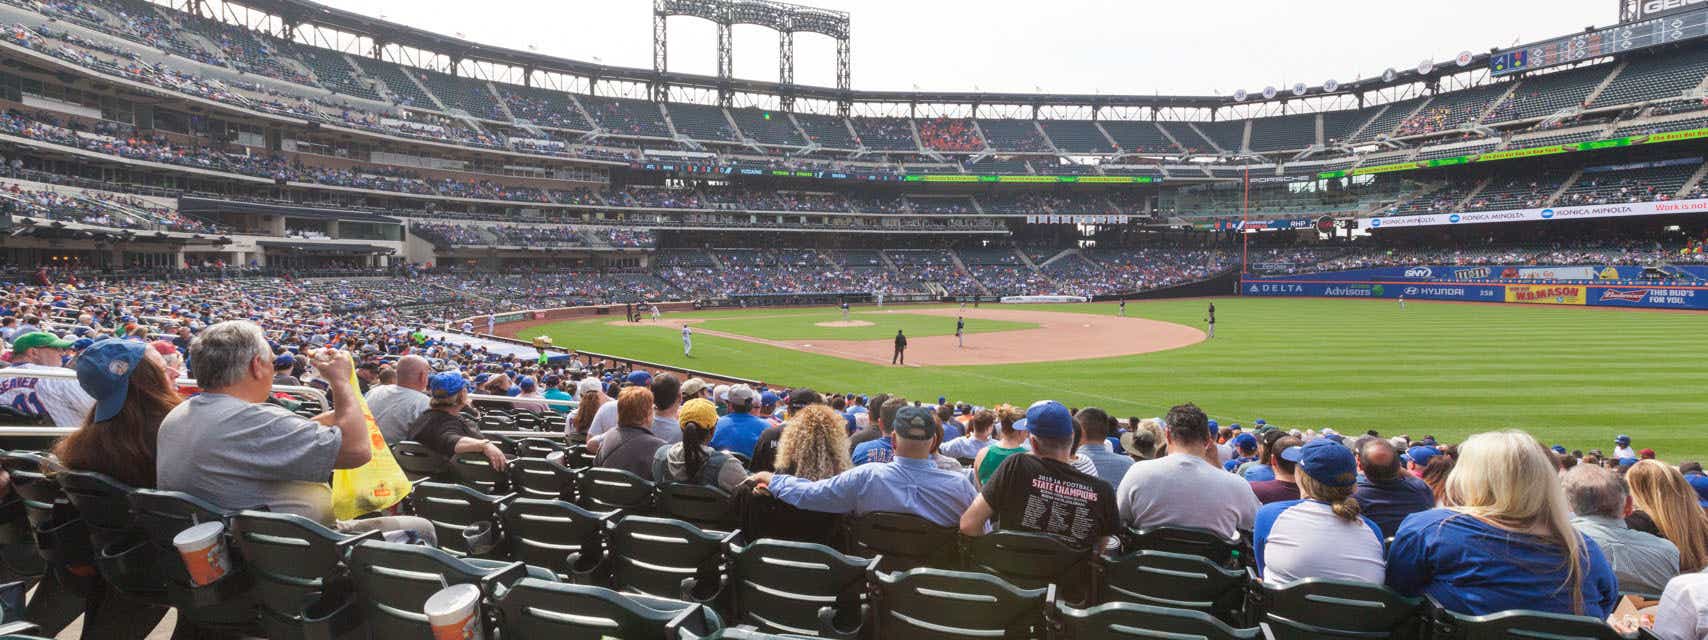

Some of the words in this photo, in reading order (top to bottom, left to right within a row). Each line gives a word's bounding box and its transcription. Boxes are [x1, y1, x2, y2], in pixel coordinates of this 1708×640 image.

[1556, 208, 1590, 217] KONICA
[1592, 205, 1633, 215] MINOLTA
[1656, 203, 1680, 212] Work
[1692, 201, 1708, 209] not
[1382, 217, 1406, 225] KONICA
[1407, 215, 1436, 224] MINOLTA
[1461, 212, 1490, 221] KONICA
[1492, 210, 1525, 219] MINOLTA
[1290, 219, 1306, 228] RHP
[1262, 284, 1304, 293] DELTA
[1324, 286, 1372, 297] Advisors
[1420, 287, 1465, 297] HYUNDAI
[1650, 289, 1668, 297] THIS
[1032, 478, 1055, 491] STATE
[1054, 484, 1099, 502] CHAMPIONS
